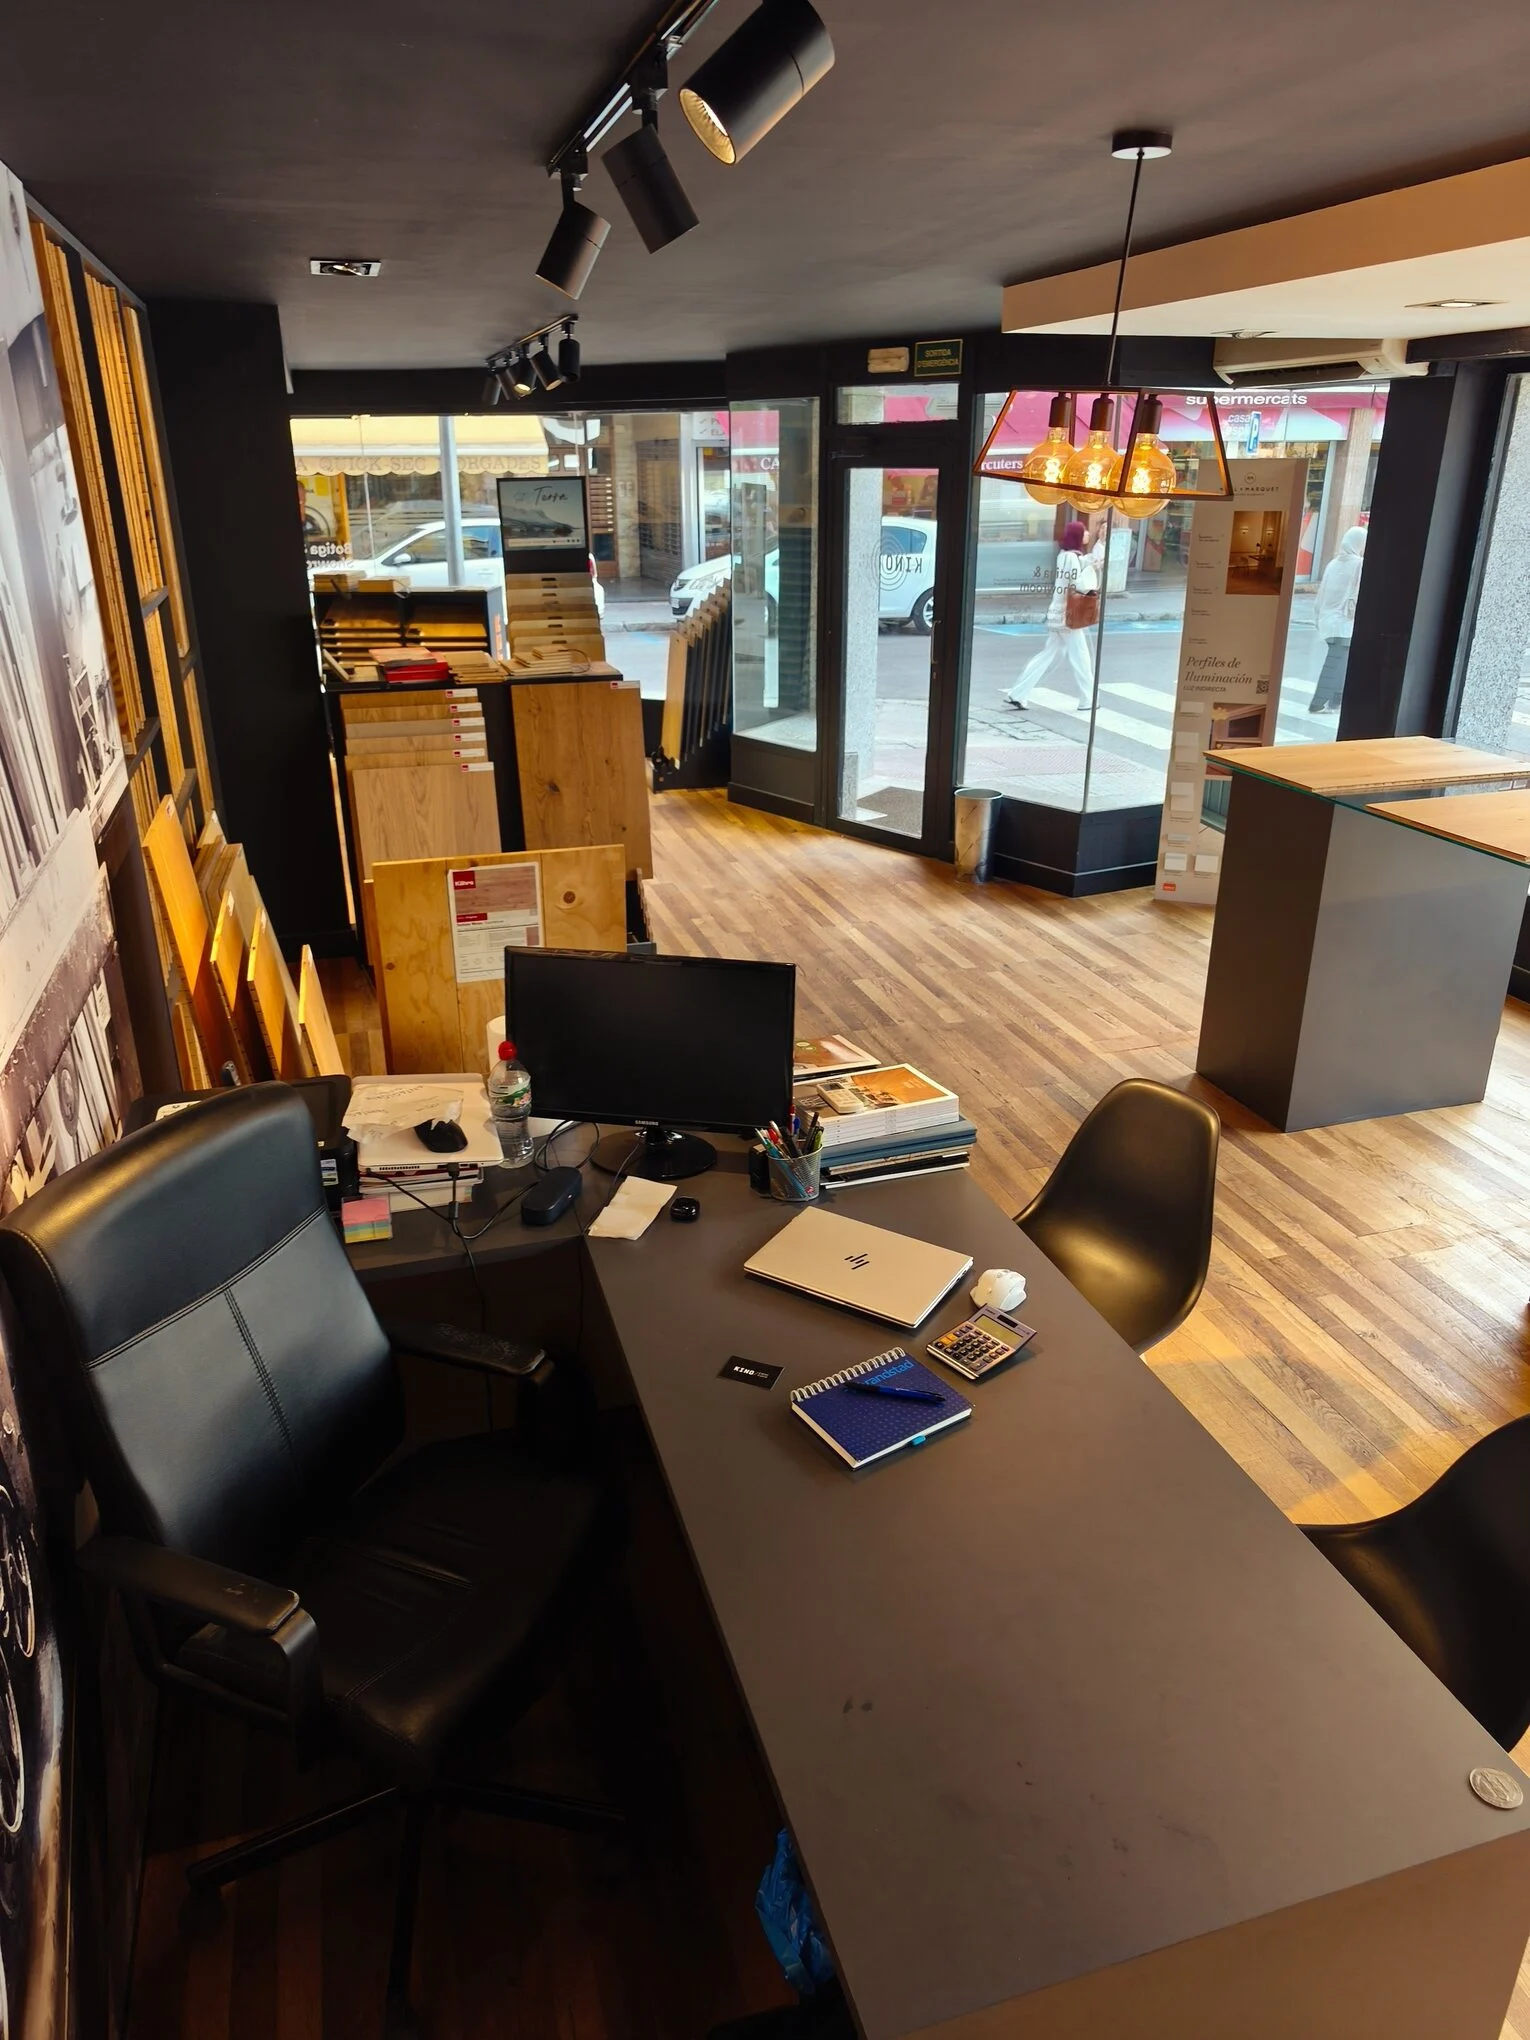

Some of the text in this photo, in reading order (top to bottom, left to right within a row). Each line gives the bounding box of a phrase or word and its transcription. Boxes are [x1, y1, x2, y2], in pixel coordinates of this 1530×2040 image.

[1186, 656, 1242, 670] Perfiles de
[1185, 671, 1253, 684] Iluminación
[864, 1360, 915, 1386] randstad
